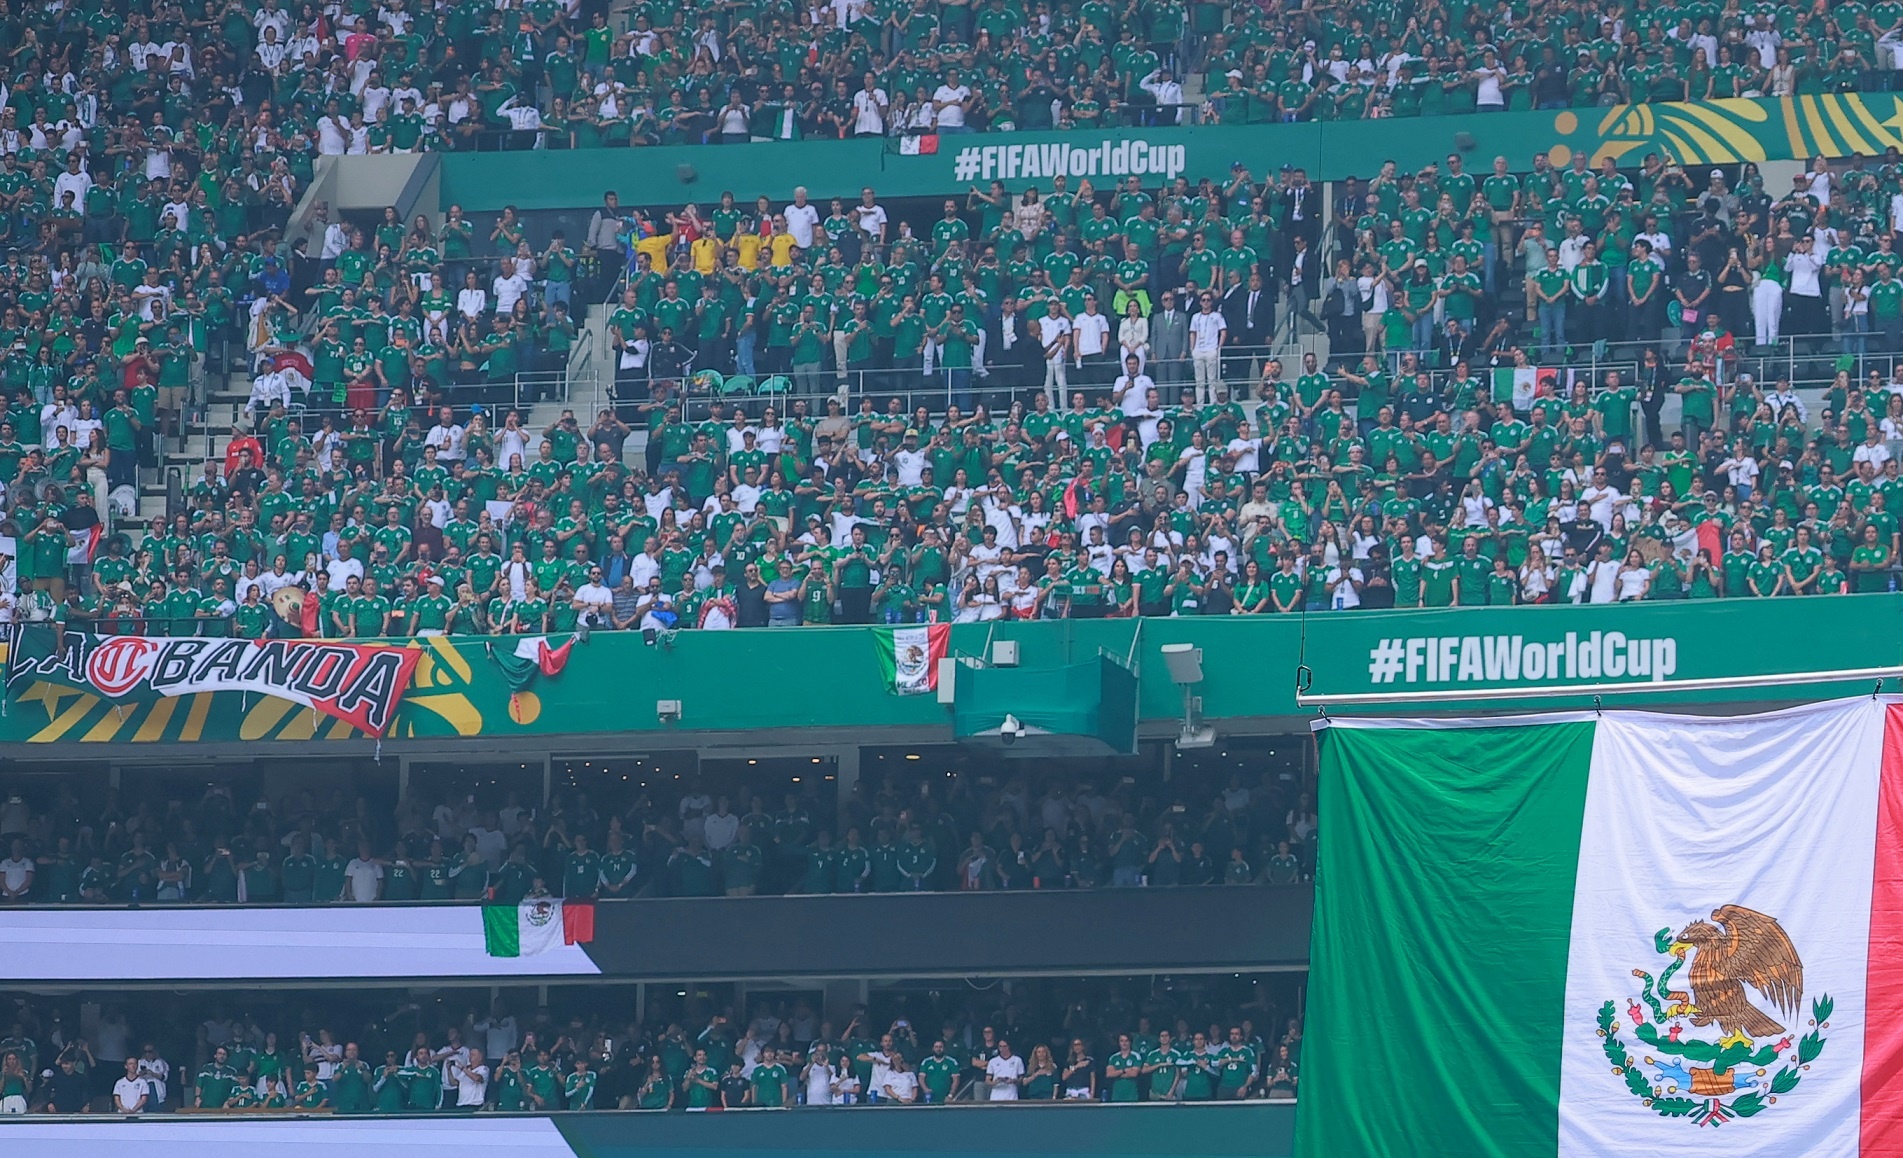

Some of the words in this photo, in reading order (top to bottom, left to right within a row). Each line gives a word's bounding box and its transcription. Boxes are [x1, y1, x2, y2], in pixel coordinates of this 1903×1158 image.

[954, 138, 1186, 182] #FIFAWorldCup
[737, 551, 746, 560] 10
[812, 590, 821, 603] 9
[7, 626, 86, 688] LA
[150, 639, 404, 729] BANDA
[1369, 631, 1677, 683] #FIFAWorldCup
